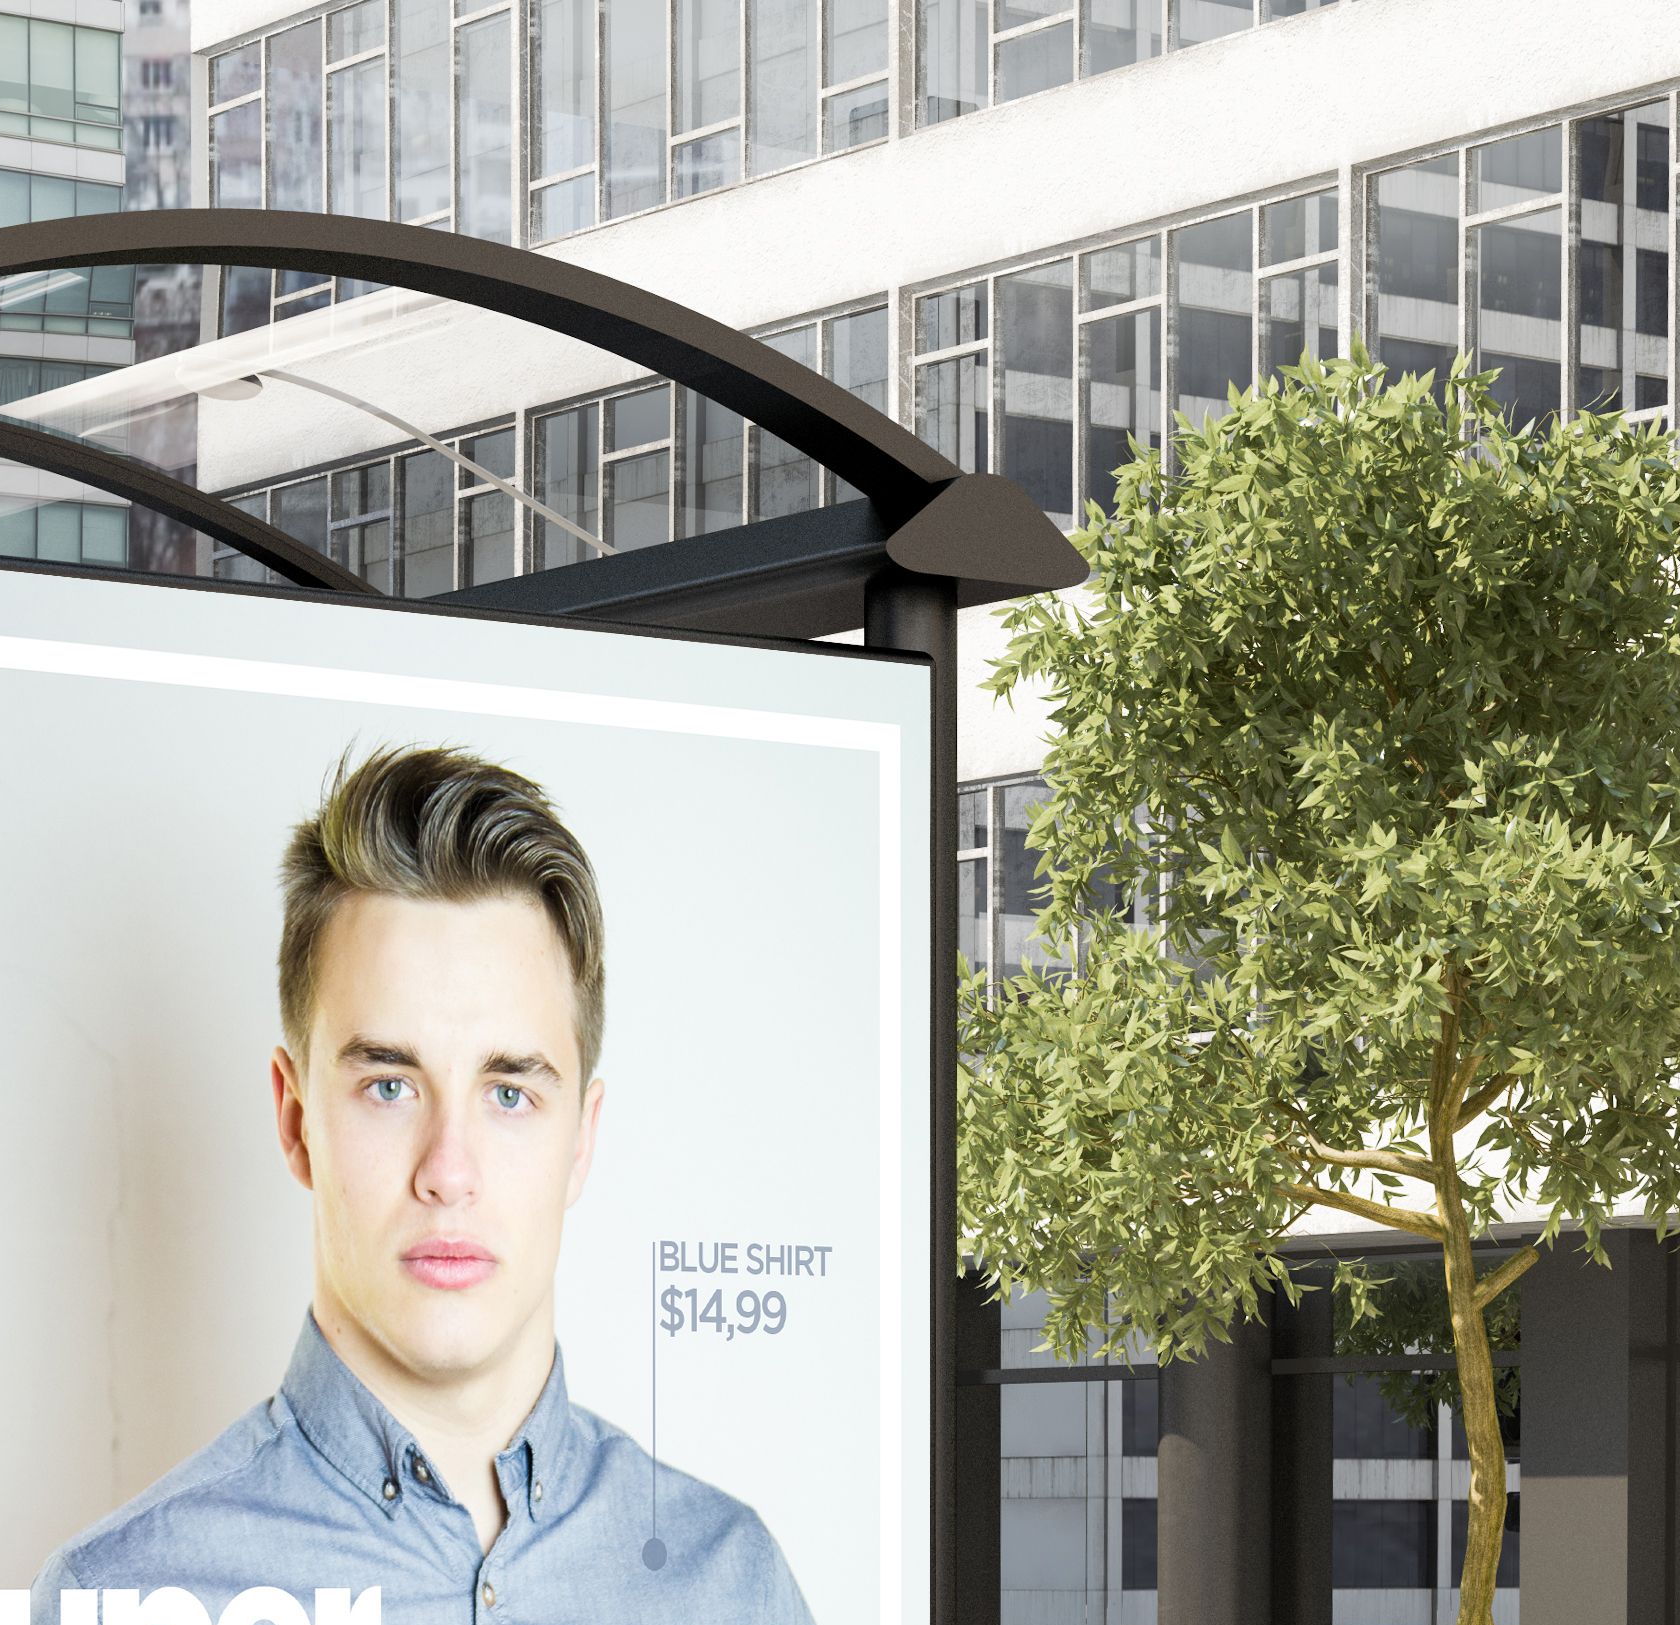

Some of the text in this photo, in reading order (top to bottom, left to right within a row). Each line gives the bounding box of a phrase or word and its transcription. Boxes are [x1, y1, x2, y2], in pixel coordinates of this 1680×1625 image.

[659, 1240, 833, 1277] BLUE SHIRT
[659, 1284, 787, 1342] $14,99
